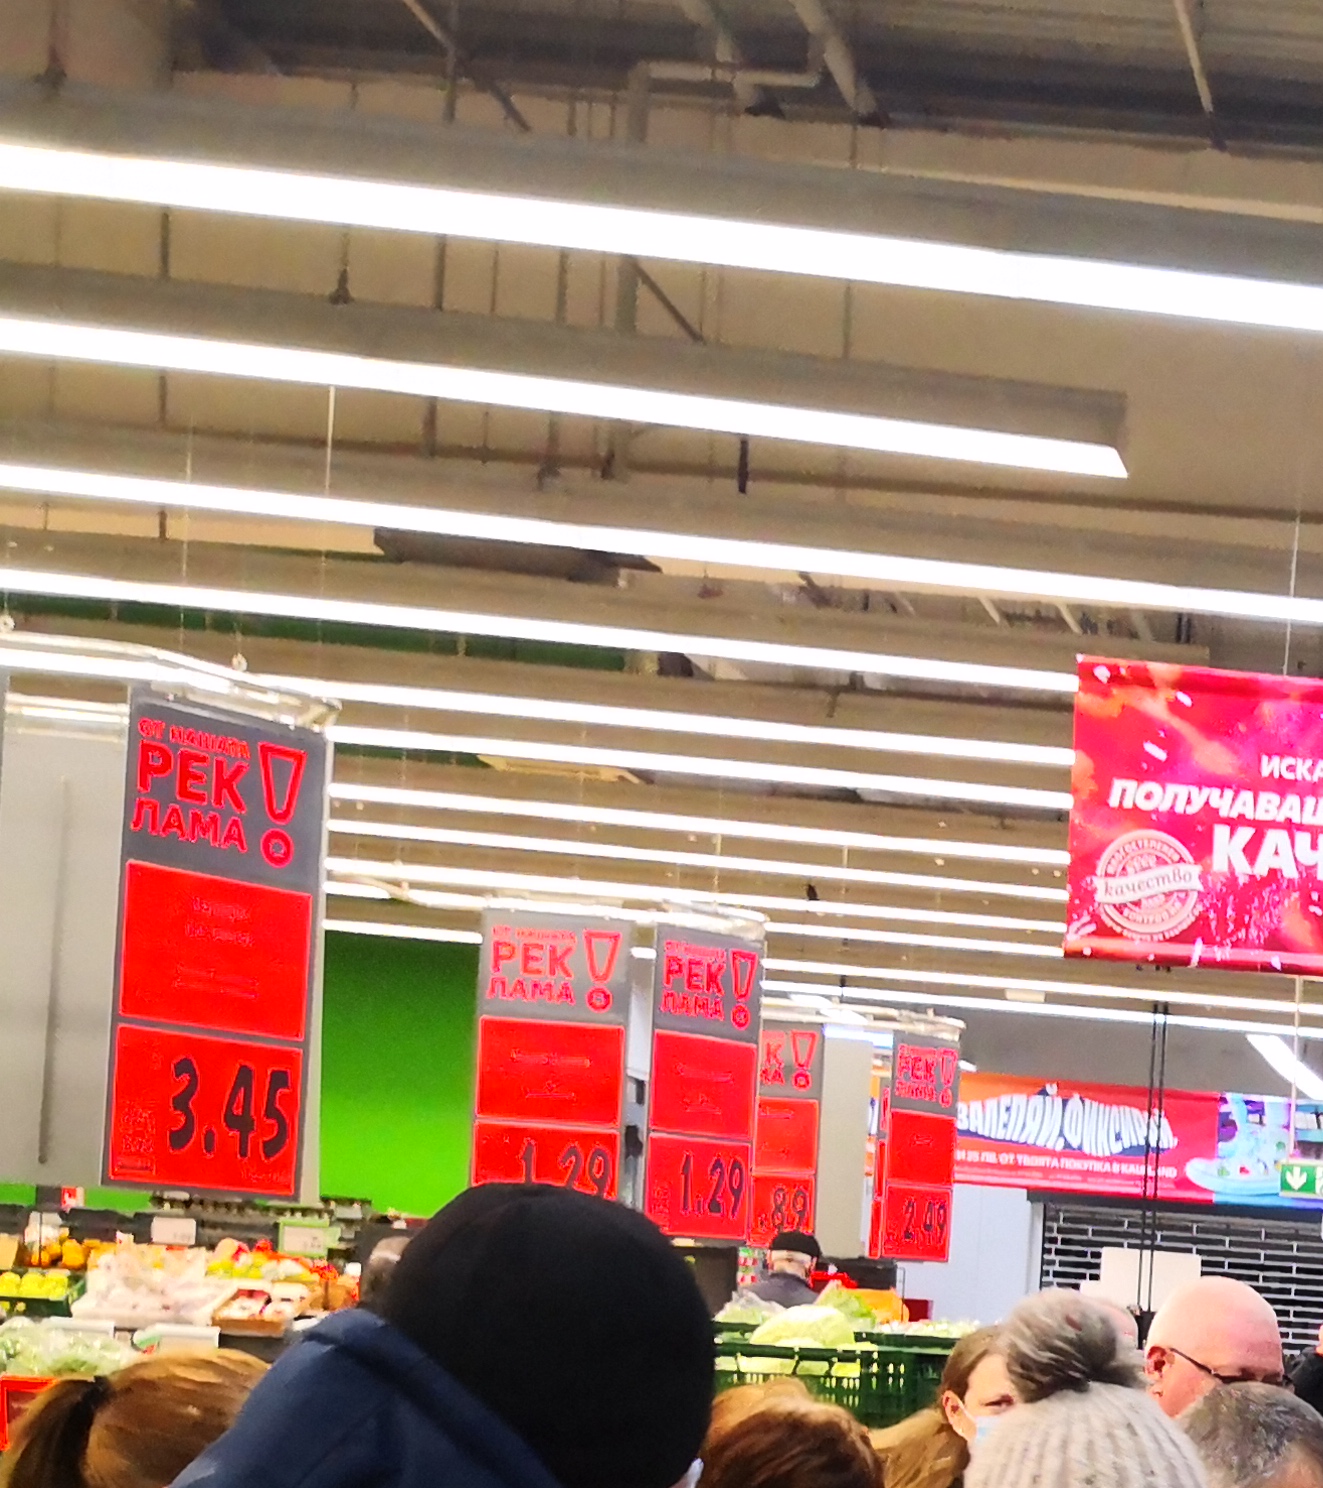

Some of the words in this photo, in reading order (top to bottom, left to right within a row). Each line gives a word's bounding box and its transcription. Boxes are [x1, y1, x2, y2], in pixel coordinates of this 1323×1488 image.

[136, 738, 249, 815] РЕК
[130, 796, 248, 854] ЛАМА
[490, 939, 575, 980] РЕК
[663, 954, 726, 998] РЕК
[486, 976, 576, 1006] ЛАМА
[167, 1056, 292, 1163] 3.45
[680, 1151, 745, 1219] 1.29
